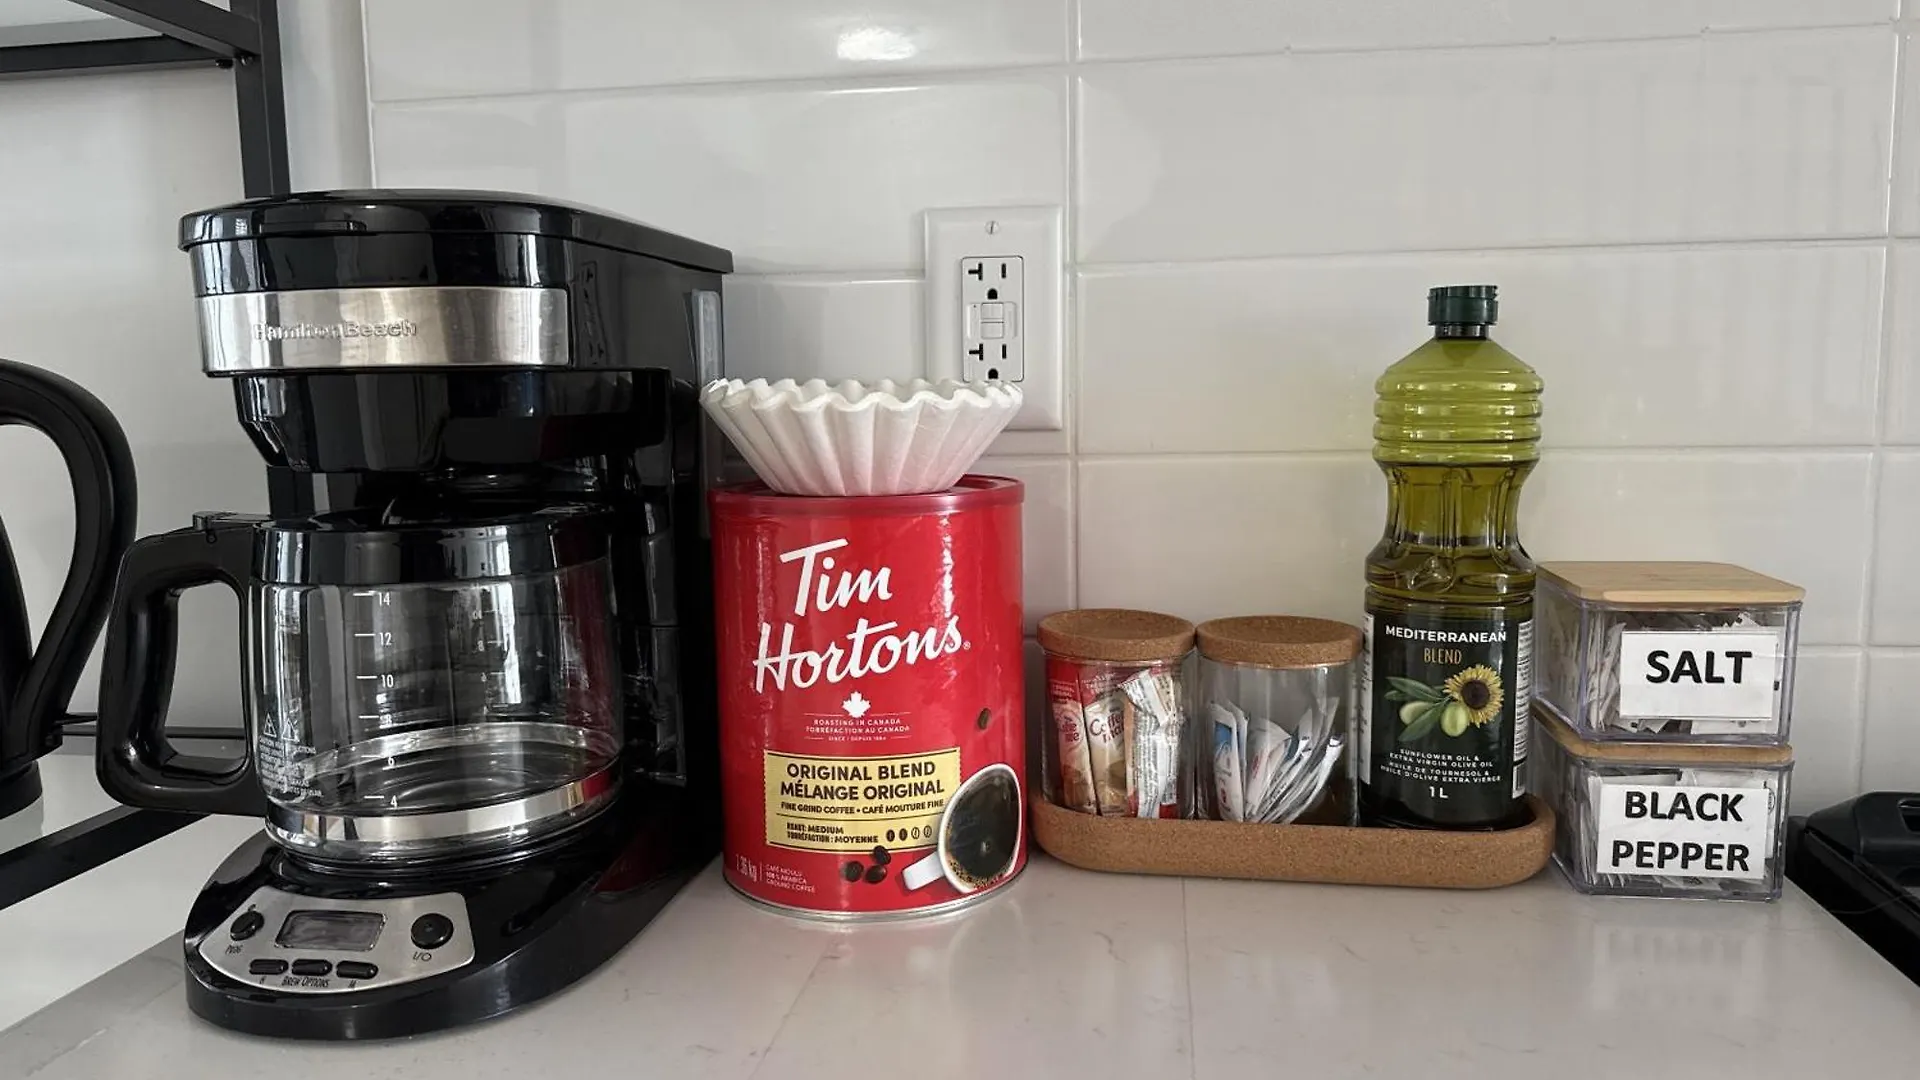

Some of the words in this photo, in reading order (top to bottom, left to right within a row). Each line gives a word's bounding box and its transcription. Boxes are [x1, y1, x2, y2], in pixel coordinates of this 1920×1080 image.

[779, 538, 893, 617] Tim
[378, 592, 390, 606] 14
[379, 632, 392, 646] 12
[1385, 625, 1507, 643] MEDITERRANEAN
[753, 614, 963, 695] Hortons
[1424, 647, 1462, 665] BLEND
[1646, 650, 1752, 684] SALT
[381, 674, 394, 688] 10
[867, 718, 901, 726] CANADA
[877, 725, 910, 734] CANADA
[1389, 752, 1414, 763] EXTRA
[1416, 757, 1447, 767] VIRGIN
[1400, 748, 1453, 761] SUNFLOWER
[786, 763, 873, 781] ORIGINAL
[878, 761, 936, 779] BLEND
[1430, 769, 1482, 777] TOURNESOL
[1442, 776, 1471, 784] EXTRA
[780, 778, 859, 800] MÉLANGE
[863, 779, 945, 800] ORIGINAL
[1429, 786, 1436, 798] 1
[1439, 787, 1449, 799] L
[390, 795, 398, 808] 4
[781, 801, 797, 812] FINE
[797, 803, 822, 814] GRIND
[823, 805, 855, 815] COFFEE
[862, 803, 884, 815] CAFÉ
[885, 801, 926, 813] MOUTURE
[927, 799, 944, 810] FINE
[1624, 790, 1744, 822] BLACK
[807, 824, 844, 835] MEDIUM
[834, 834, 879, 844] MOYENNE
[1611, 840, 1750, 872] PEPPER
